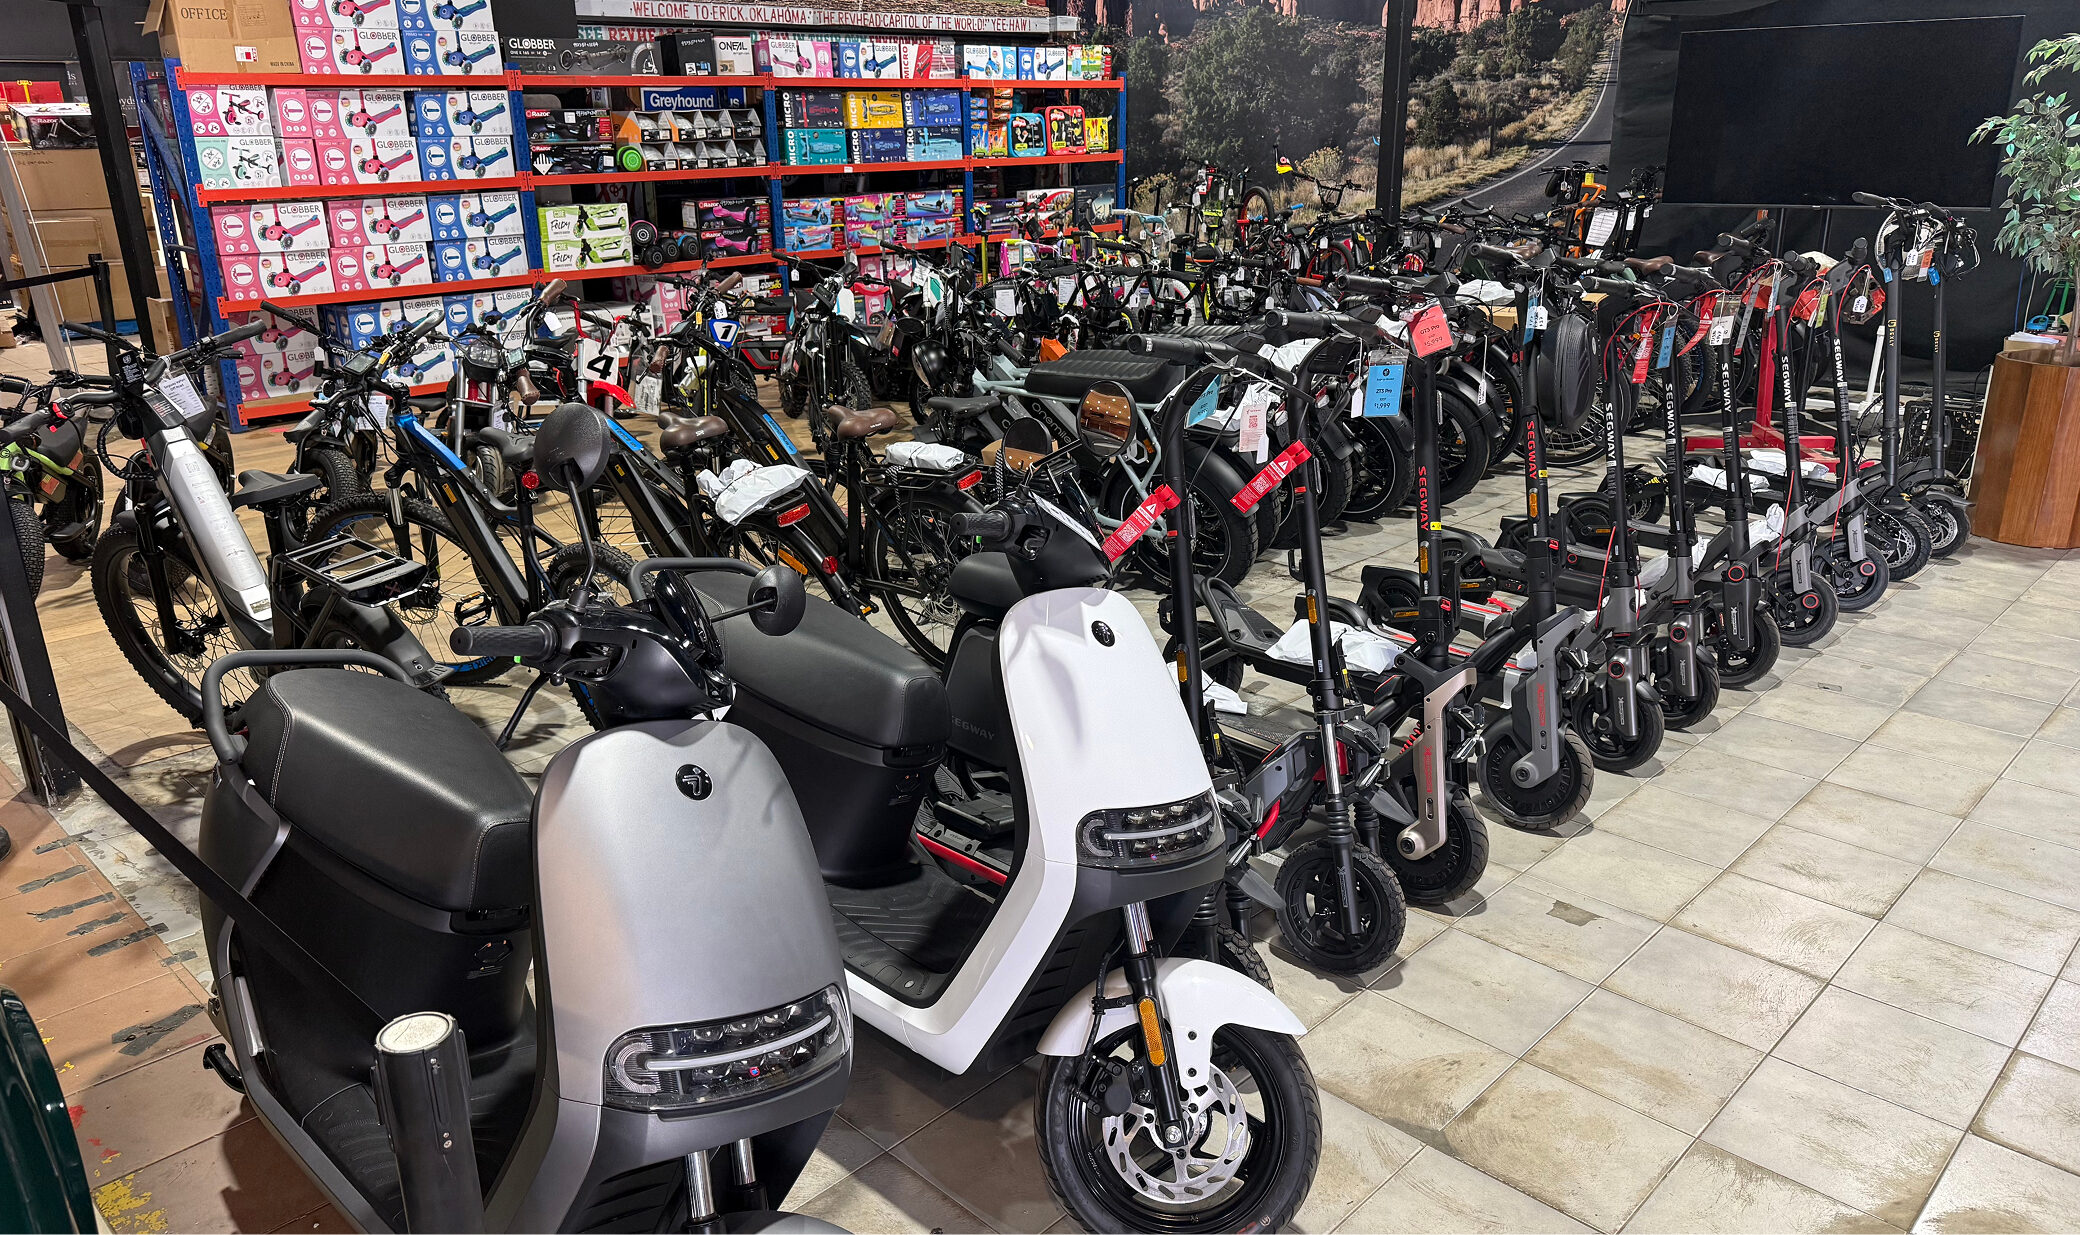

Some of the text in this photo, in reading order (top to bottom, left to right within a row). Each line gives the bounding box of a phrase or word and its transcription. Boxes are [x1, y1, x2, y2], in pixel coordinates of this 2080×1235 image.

[181, 8, 228, 21] OFFICE
[633, 1, 690, 19] WELCOME
[694, 4, 709, 20] TO
[922, 15, 933, 29] OF
[936, 15, 953, 30] THE
[359, 31, 398, 41] GLOBBER
[460, 33, 497, 43] GLOBBER
[508, 37, 557, 51] GLOBBER
[902, 45, 910, 79] MICRO
[365, 93, 403, 102] GLOBBER
[471, 92, 507, 101] GLOBBER
[650, 94, 715, 110] Greyhound
[782, 92, 793, 128] MICRO
[850, 93, 858, 127] MICRO
[904, 92, 914, 125] MICRO
[239, 138, 273, 147] GLOBBER
[377, 140, 415, 150] GLOBBER
[475, 138, 509, 147] GLOBBER
[787, 130, 797, 166] MICRO
[851, 130, 861, 164] MICRO
[906, 128, 915, 161] MICRO
[388, 199, 425, 209] GLOBBER
[483, 193, 518, 203] GLOBBER
[279, 204, 321, 215] GLOBBER
[388, 244, 425, 254] GLOBBER
[488, 236, 523, 246] GLOBBER
[286, 251, 327, 262] GLOBBER
[496, 290, 531, 301] GLOBBER
[404, 299, 442, 311] GLOBBER
[720, 324, 734, 340] 1
[586, 354, 615, 379] 4
[1833, 338, 1844, 381] SEGWAY
[1721, 362, 1731, 412] SEGWAY
[1781, 355, 1791, 403] SEGWAY
[1665, 383, 1676, 438] SEGWAY
[1605, 402, 1616, 461] SEGWAY
[1526, 420, 1537, 480] SEGWAY
[1418, 466, 1429, 531] SEGWAY
[952, 715, 994, 740] EGWAY
